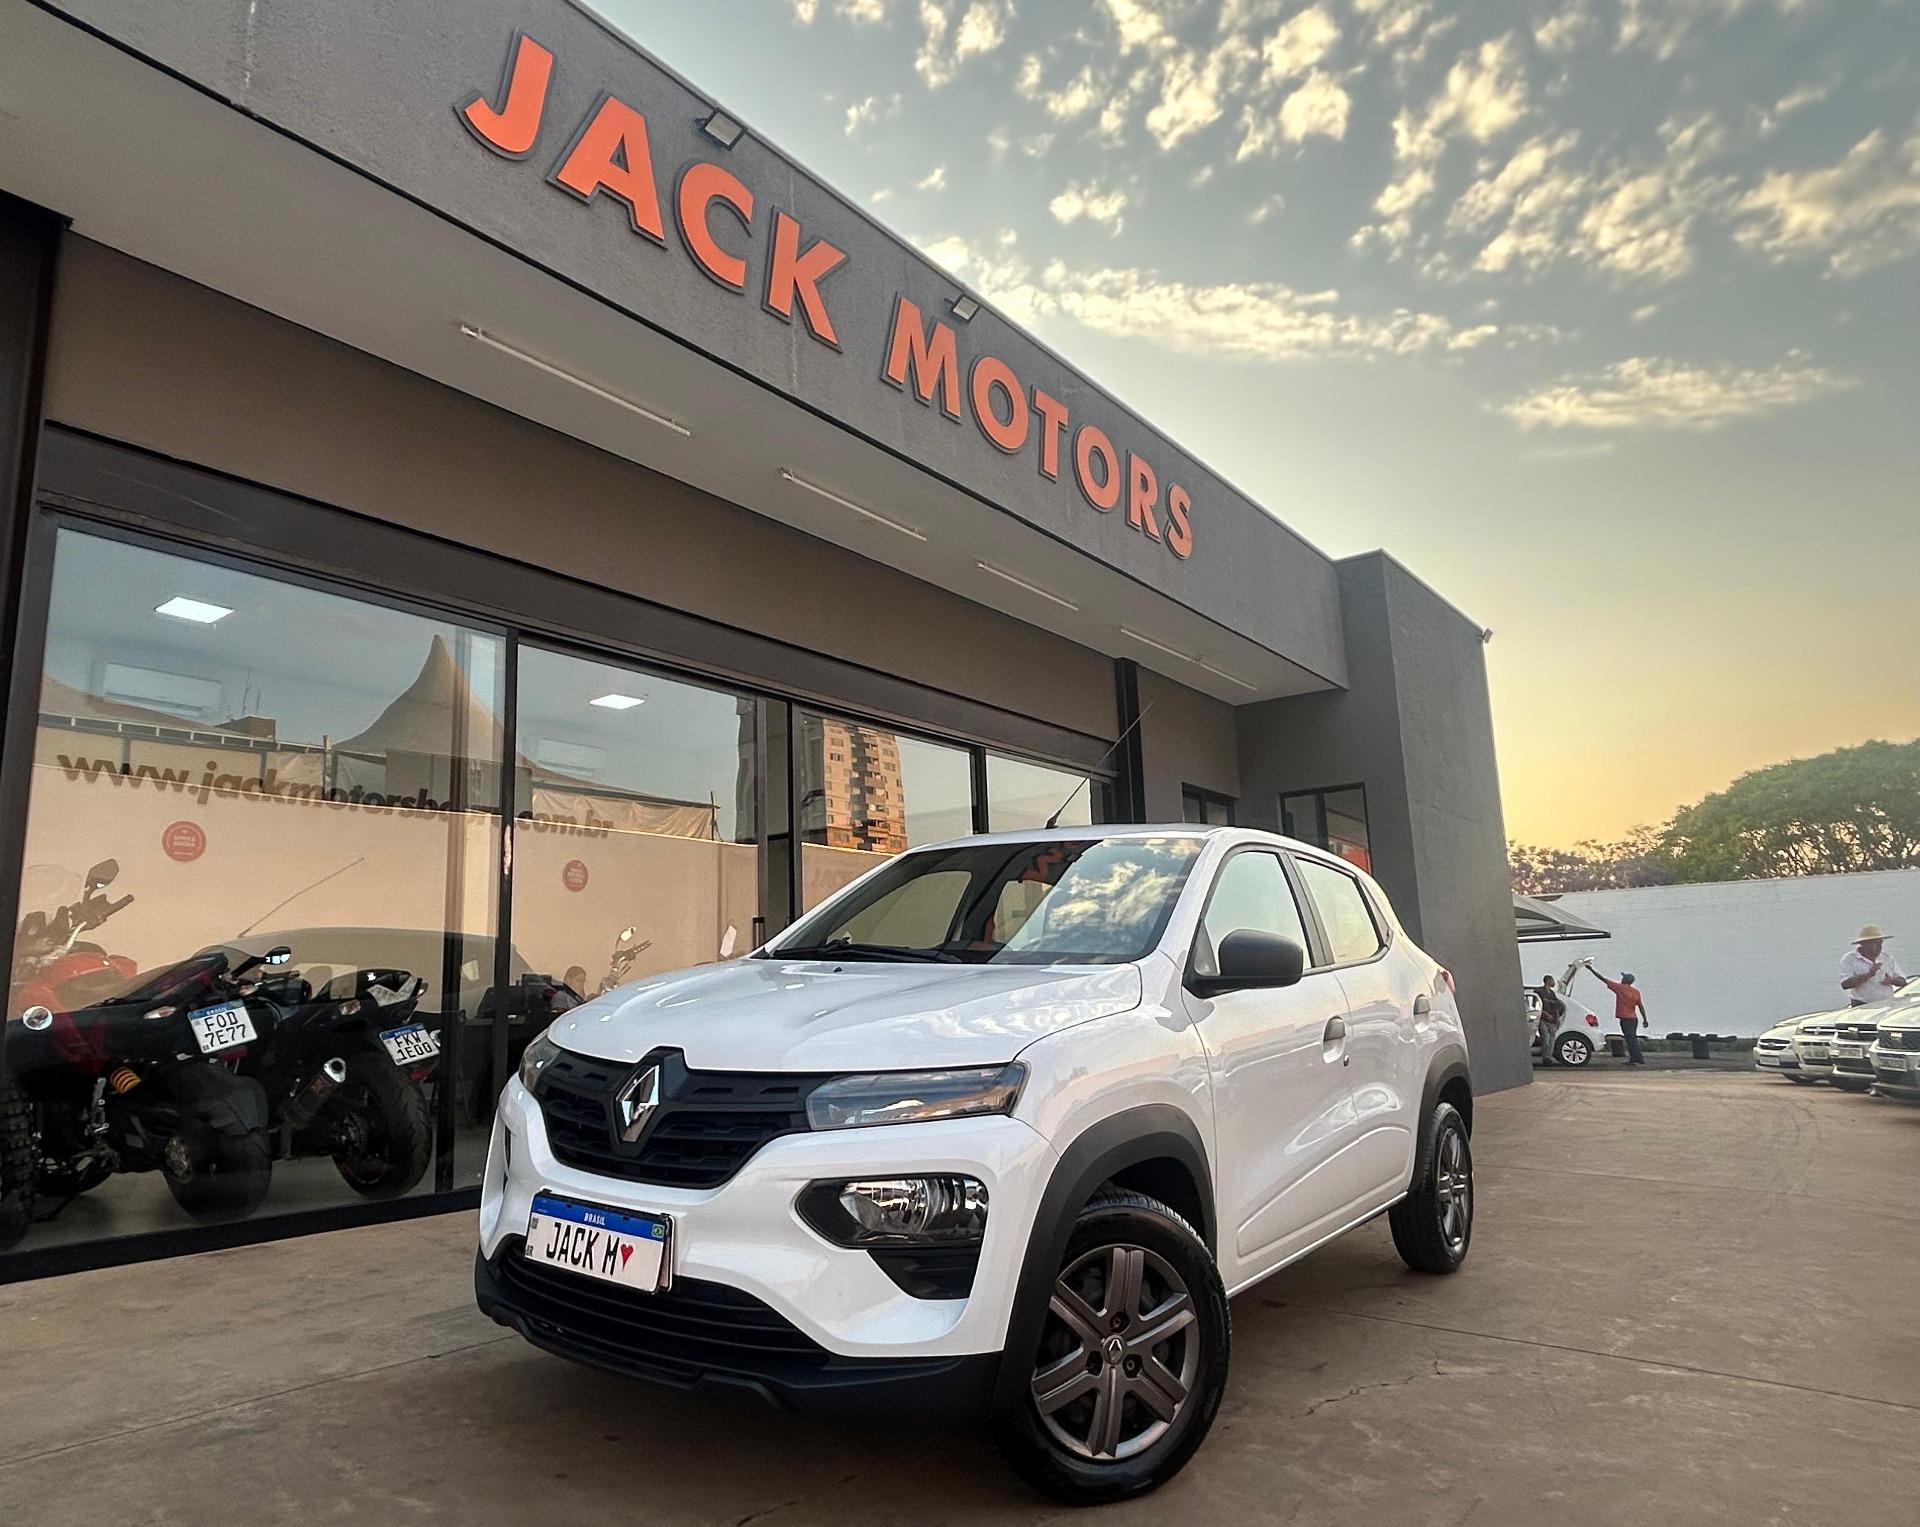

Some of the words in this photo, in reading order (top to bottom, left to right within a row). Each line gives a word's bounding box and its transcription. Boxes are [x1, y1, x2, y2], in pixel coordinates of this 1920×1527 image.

[461, 33, 849, 350] JACK
[885, 296, 1193, 560] MOTORS
[57, 754, 614, 838] www.jackmotorsbcom.br
[204, 1011, 238, 1031] FOD
[205, 1024, 246, 1047] 7E77
[583, 1212, 606, 1226] BRASIL
[545, 1221, 600, 1270] JACK
[601, 1234, 620, 1276] M
